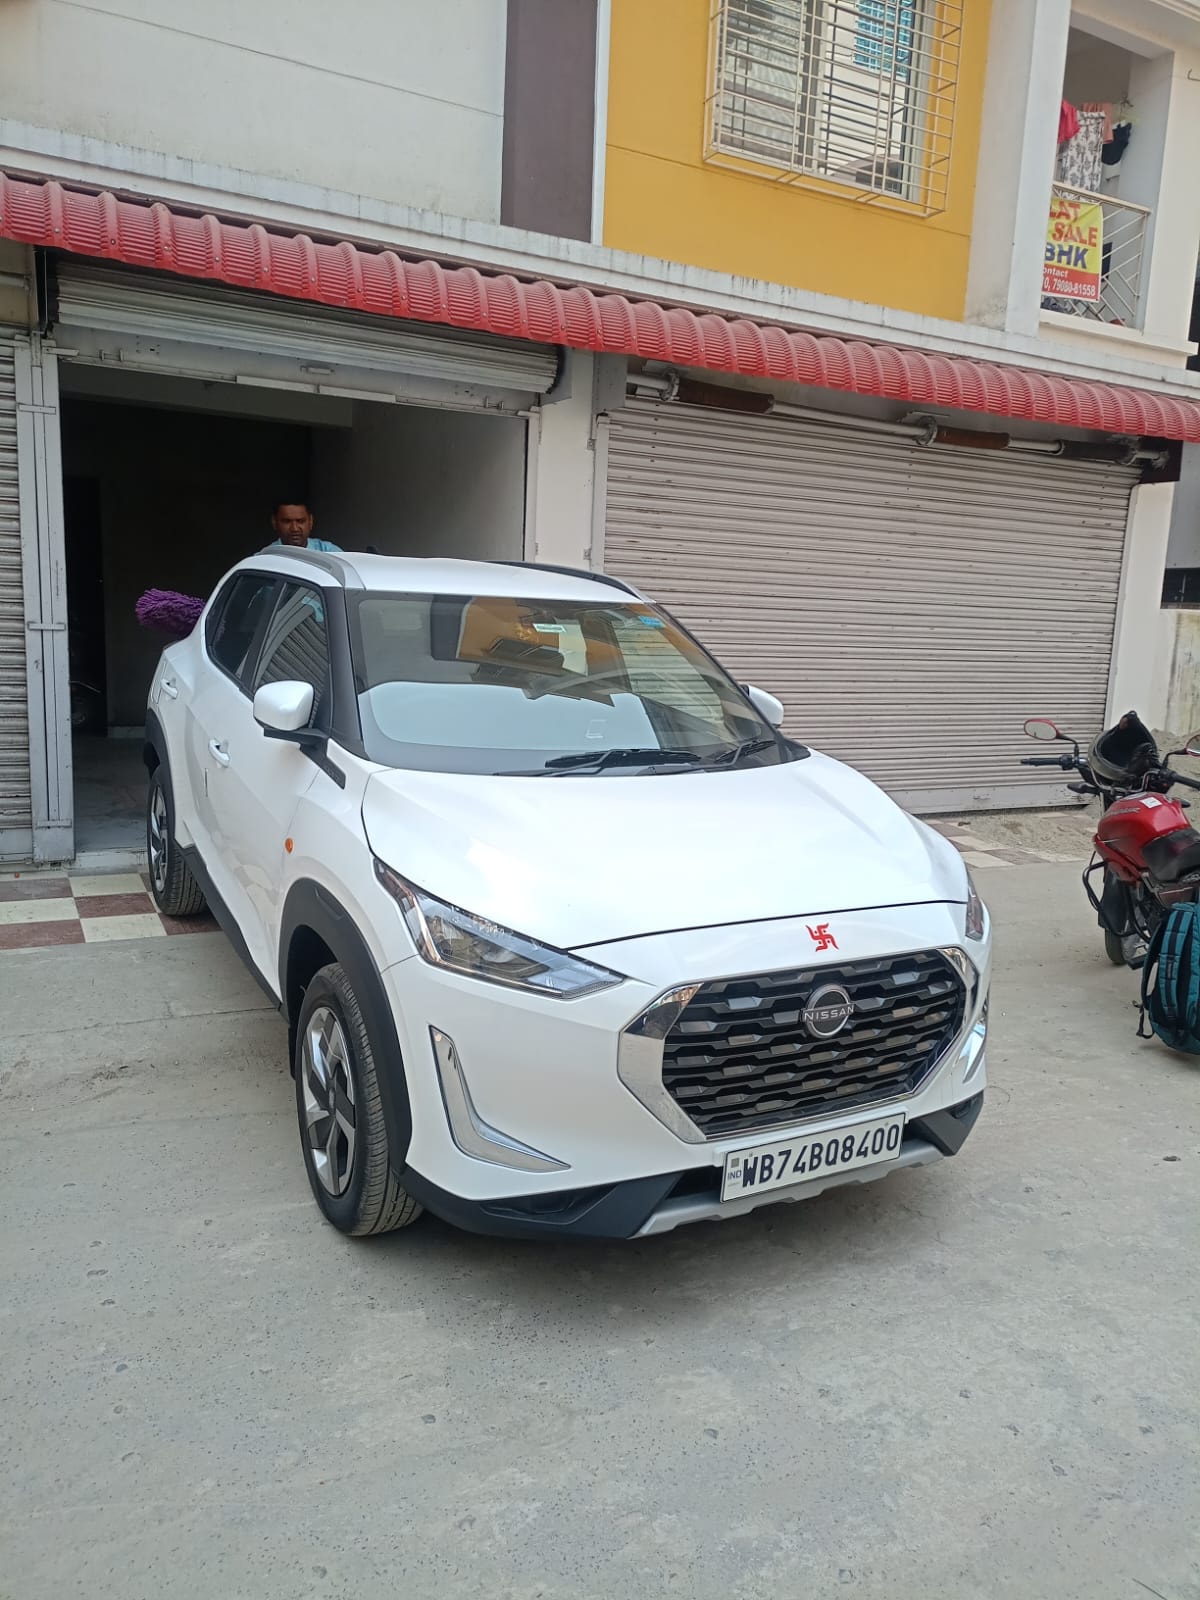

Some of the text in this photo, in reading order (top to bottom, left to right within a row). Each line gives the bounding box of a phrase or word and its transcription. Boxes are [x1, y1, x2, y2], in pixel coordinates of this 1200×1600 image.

[1052, 222, 1098, 248] SALE
[804, 1005, 854, 1021] NISSAN
[742, 1124, 900, 1188] WB74BQ8400
[728, 1169, 742, 1181] IND
